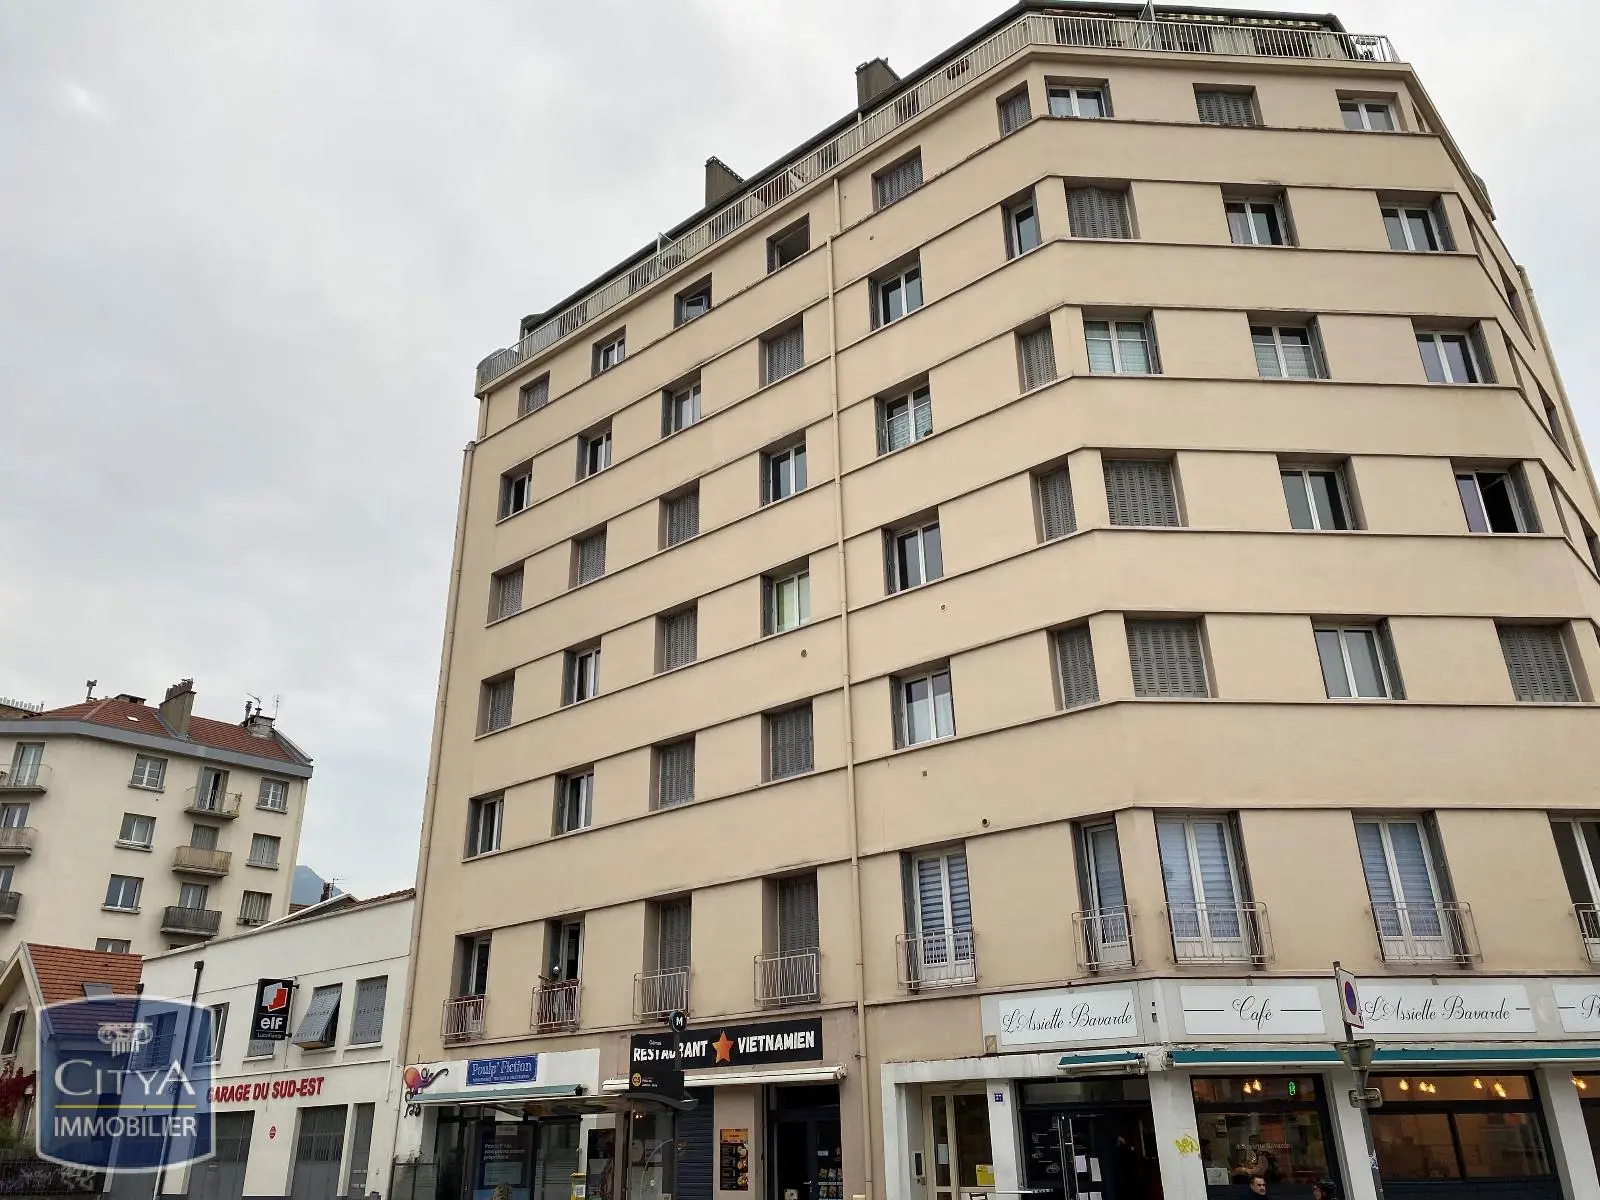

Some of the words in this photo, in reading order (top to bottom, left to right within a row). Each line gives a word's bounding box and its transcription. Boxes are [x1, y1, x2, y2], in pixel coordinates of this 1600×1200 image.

[1068, 1002, 1133, 1029] Bavarde
[1232, 995, 1272, 1031] Café
[1442, 995, 1509, 1020] Bavarde
[261, 1016, 283, 1030] elf
[676, 1016, 683, 1026] M
[737, 1030, 815, 1054] VIETNAMIEN
[500, 1060, 532, 1074] Fiction
[206, 1083, 251, 1103] GARAGE
[252, 1082, 270, 1101] DU
[272, 1077, 325, 1099] SUD-EST
